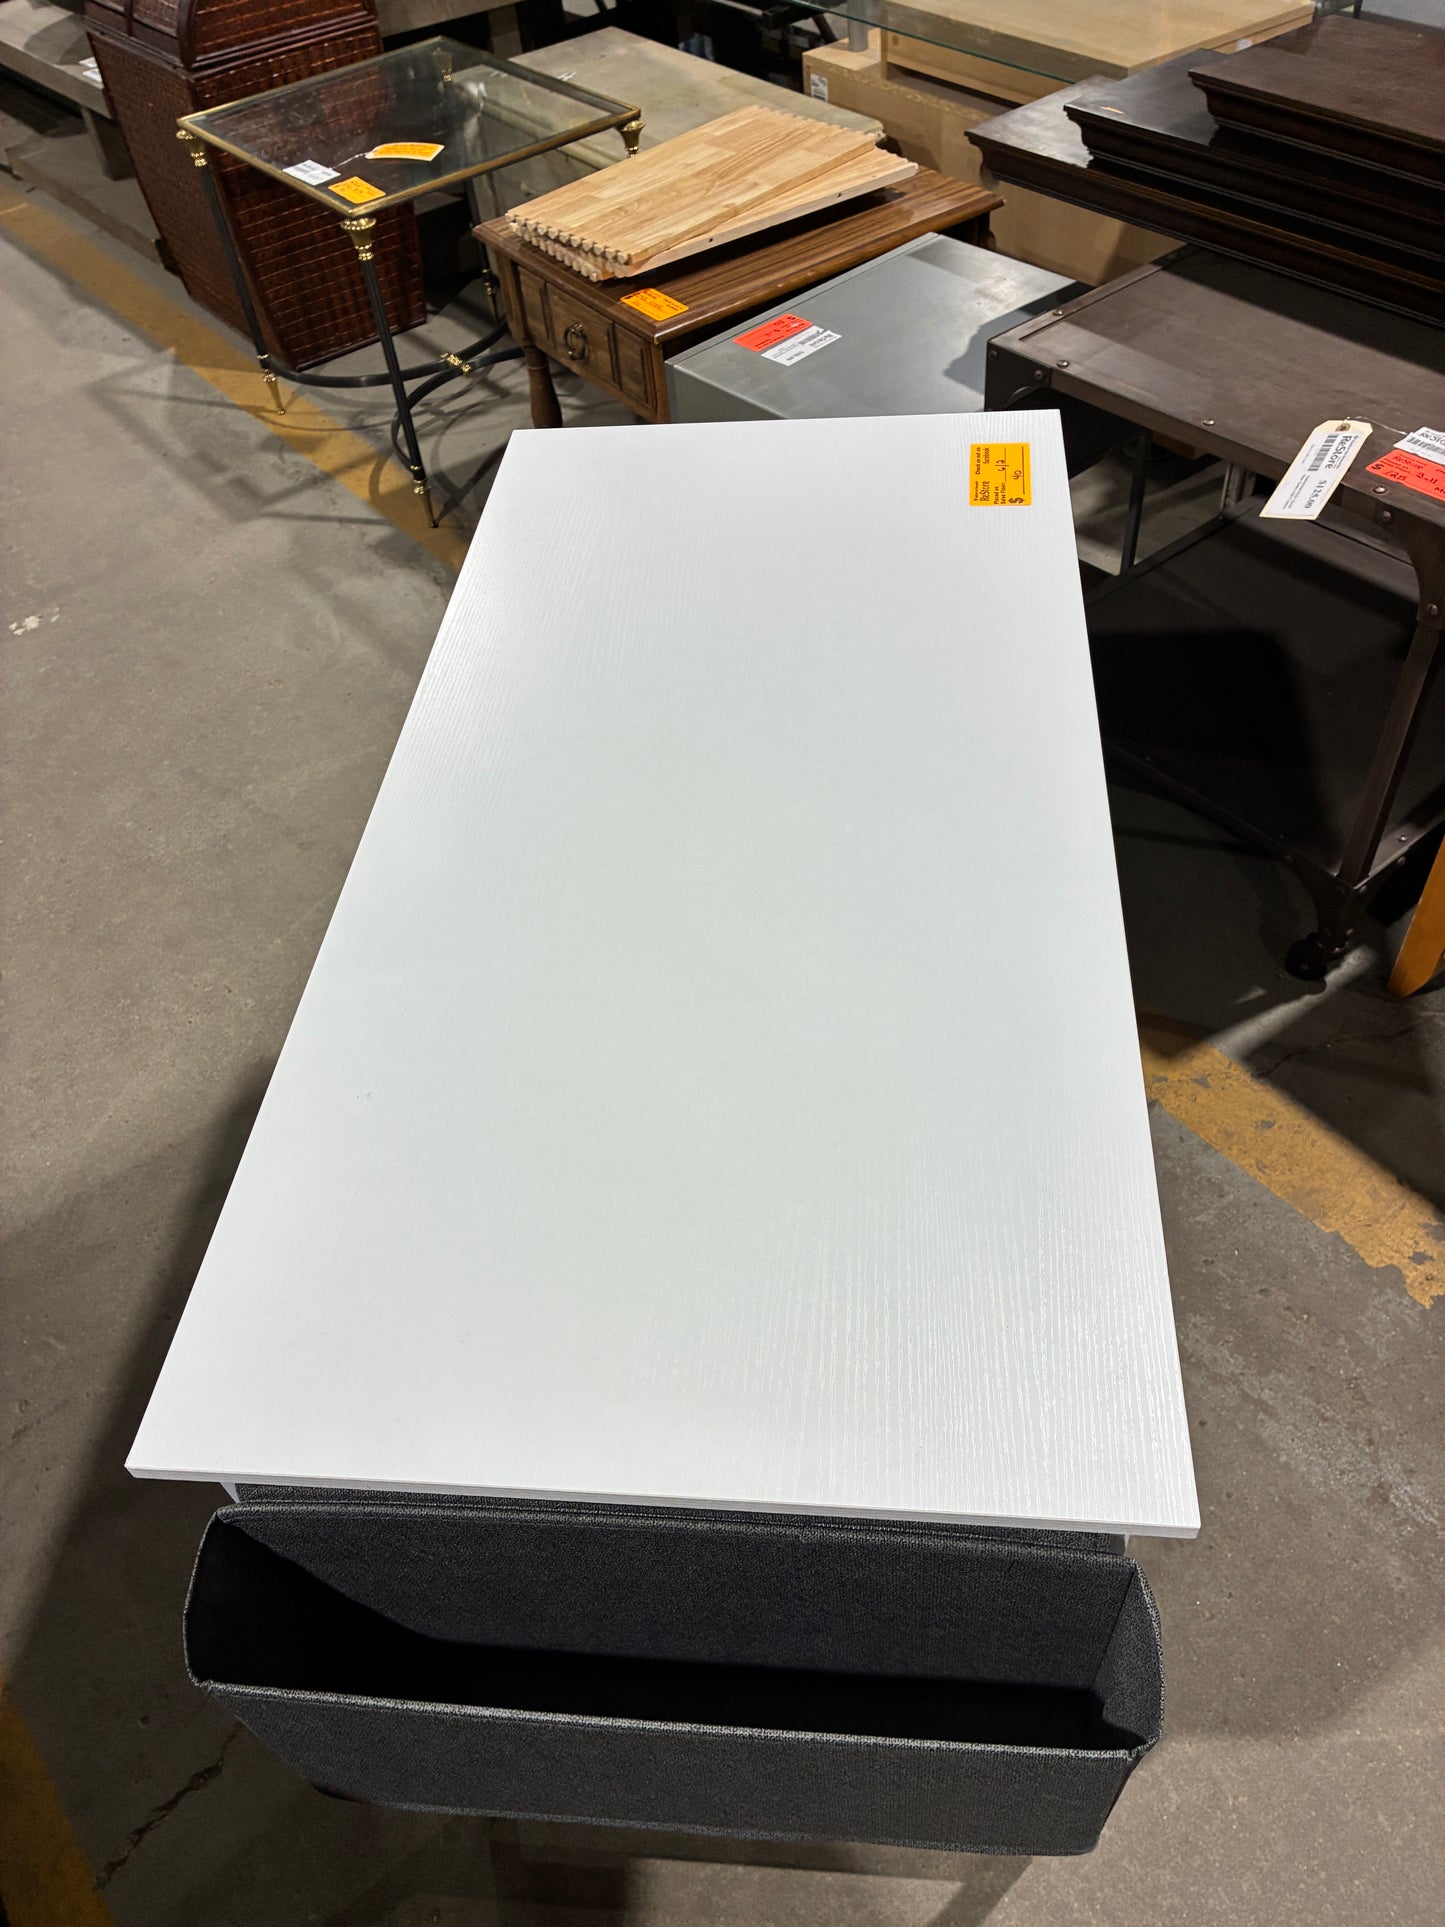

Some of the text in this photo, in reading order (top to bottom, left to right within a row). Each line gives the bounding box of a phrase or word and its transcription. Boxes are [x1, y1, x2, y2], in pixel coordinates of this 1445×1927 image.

[982, 447, 990, 464] facebook
[1325, 435, 1353, 469] ReStore
[1012, 470, 1023, 480] 40
[979, 480, 990, 502] ReStore
[1304, 480, 1327, 509] $125.00
